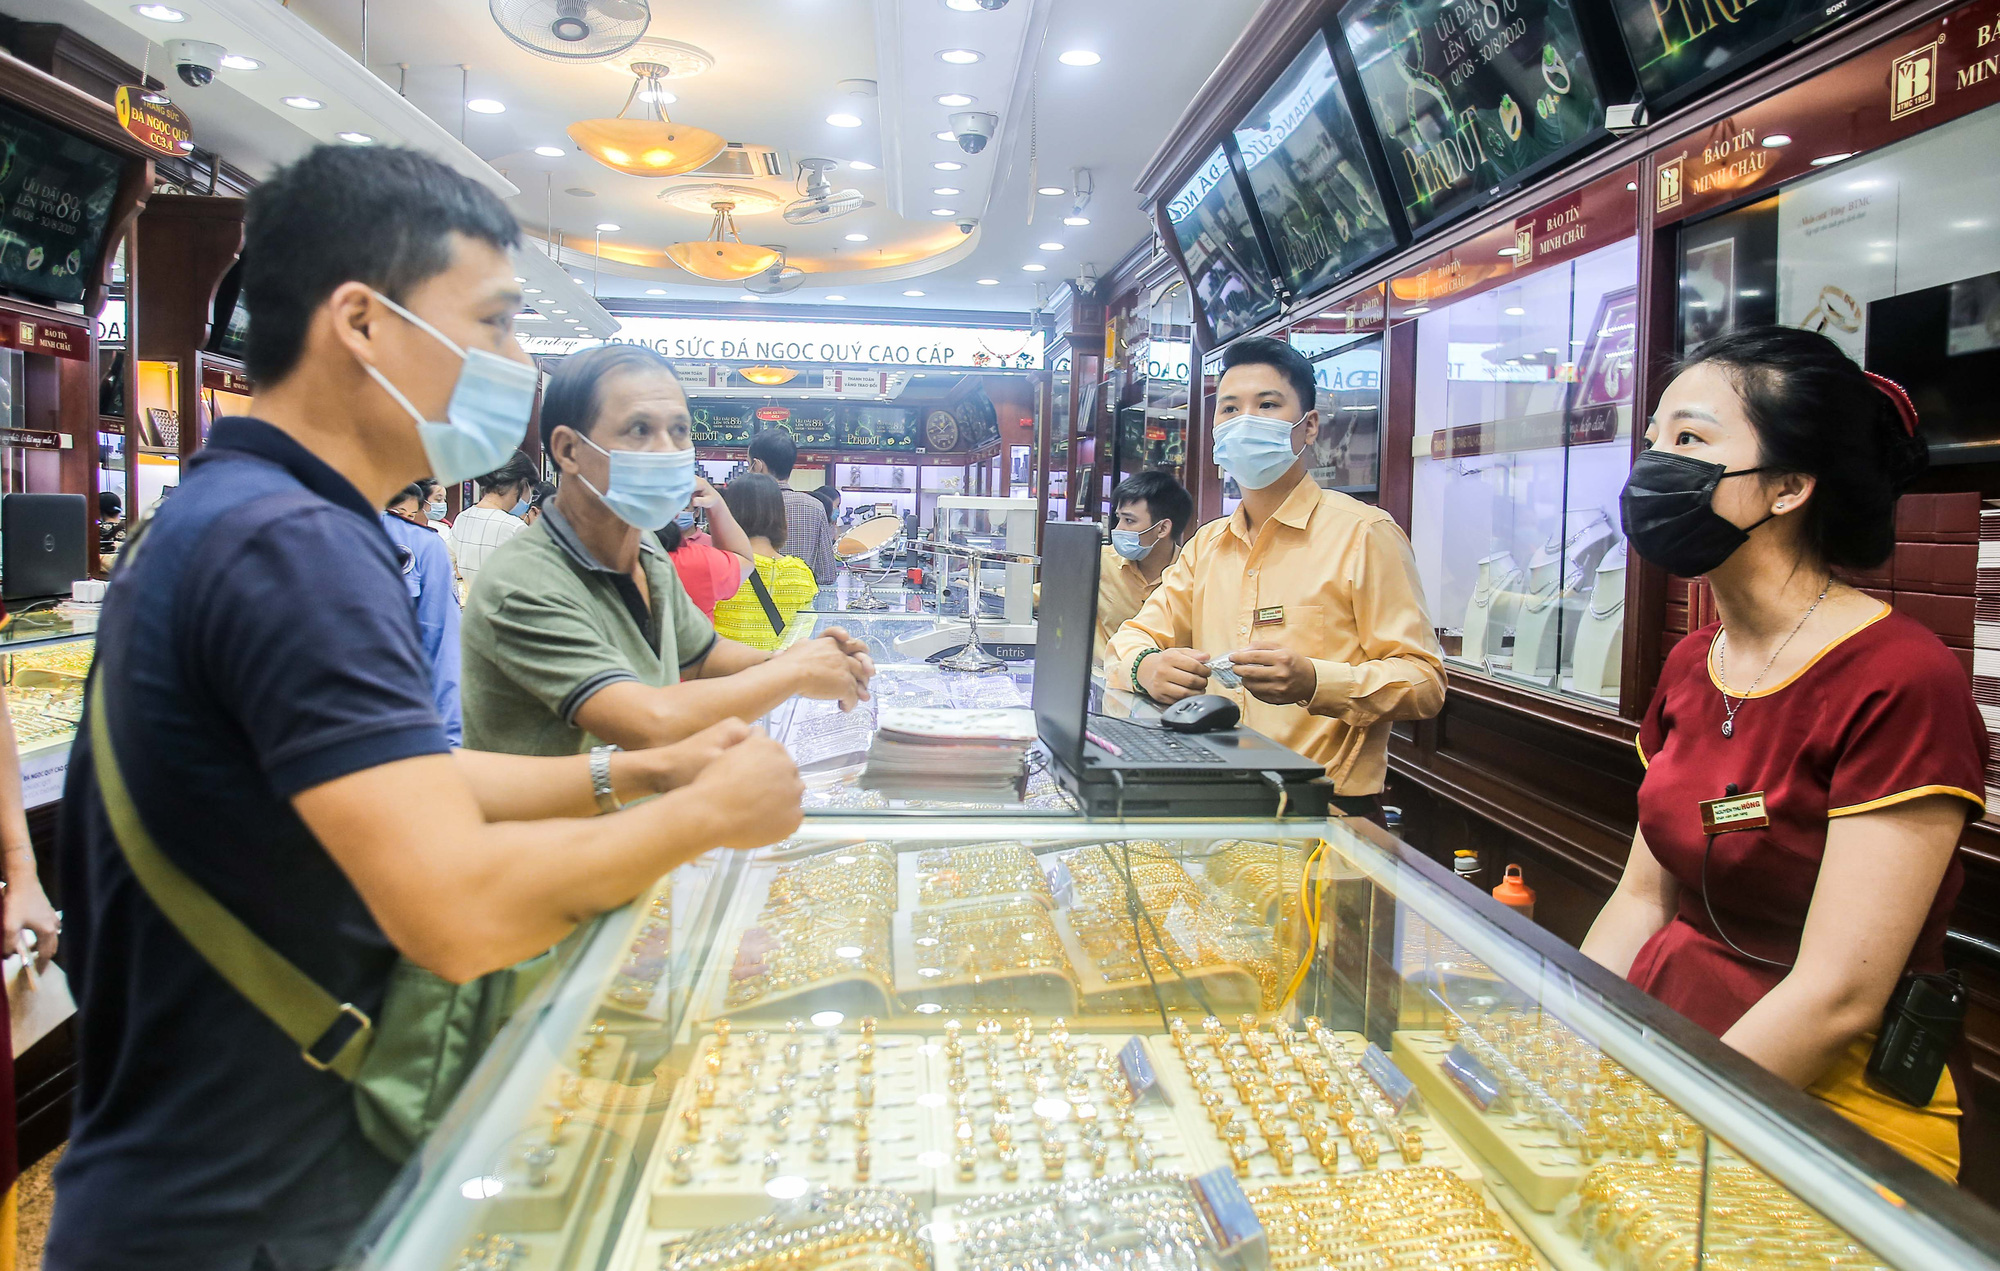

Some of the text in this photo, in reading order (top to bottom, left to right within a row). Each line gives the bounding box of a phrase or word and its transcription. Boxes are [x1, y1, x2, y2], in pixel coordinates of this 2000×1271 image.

[1825, 0, 1848, 16] SONY
[1443, 36, 1466, 66] LÊN
[1450, 59, 1475, 87] 01/08
[1479, 17, 1526, 65] 30/8/2020
[1956, 54, 2000, 91] MIN
[120, 98, 126, 115] 1
[1896, 93, 1929, 112] BTMC 1989
[131, 107, 145, 124] ĐÁ
[146, 114, 171, 136] NGỌC
[150, 132, 173, 151] CC3.4
[1402, 104, 1489, 201] PERIDOT
[1704, 128, 1756, 165] BẢO TÍN
[1693, 151, 1767, 195] MINH CHÂU
[1546, 205, 1580, 232] BẢO TÍN
[1281, 213, 1333, 277] PERIDOT
[1539, 224, 1587, 255] MINH CHÂU
[40, 338, 72, 352] MINH CHÂU
[44, 327, 68, 340] BẢO TÍN
[676, 336, 715, 357] SỨC
[720, 338, 749, 358] ĐÁ
[820, 341, 863, 361] QUÝ
[868, 344, 910, 363] CAO
[916, 341, 955, 364] CẤP
[690, 430, 719, 441] ERIDOT
[847, 433, 882, 445] PERIDOT
[996, 646, 1026, 657] Entris
